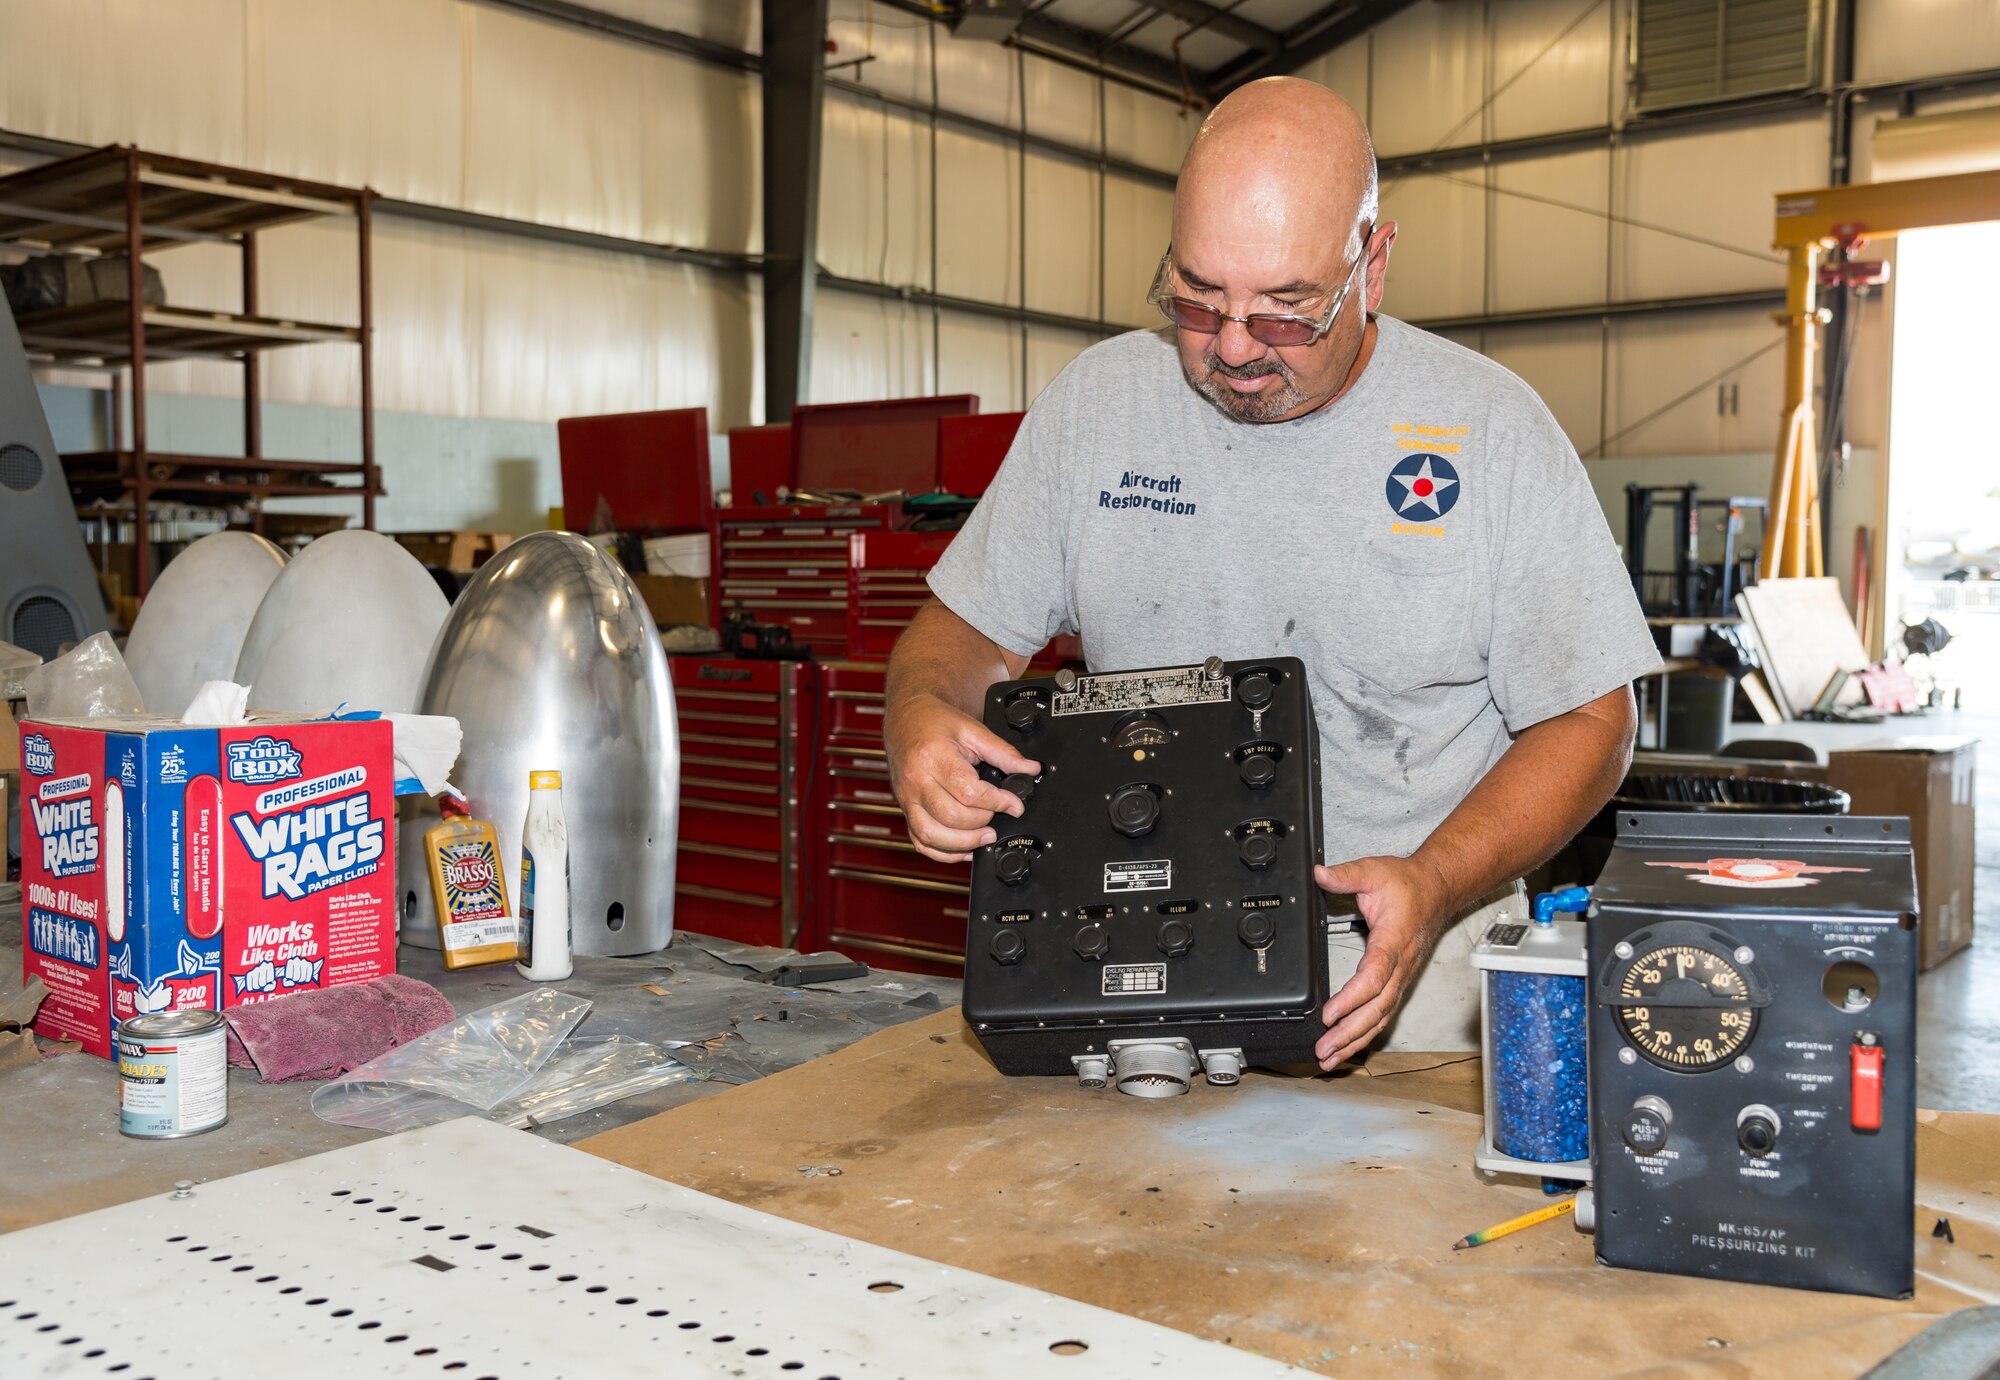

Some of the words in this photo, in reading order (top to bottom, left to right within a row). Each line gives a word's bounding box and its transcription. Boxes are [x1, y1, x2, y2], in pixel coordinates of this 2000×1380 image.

[1392, 423, 1412, 433] AIR
[1416, 424, 1470, 436] MOBILITY
[1397, 438, 1461, 454] COMMAND
[1119, 470, 1182, 492] Aircraft
[1099, 490, 1196, 514] Restoration
[1391, 522, 1445, 537] MUSEUM
[26, 741, 51, 754] TOOL
[232, 744, 294, 759] TOOL
[26, 754, 54, 770] BOX
[161, 758, 185, 774] 25%
[234, 756, 298, 777] BOX
[42, 776, 89, 796] PROFESSIONAL
[264, 770, 363, 809] PROFESSIONAL
[31, 798, 92, 836] WHITE
[200, 809, 210, 832] Easy
[1250, 820, 1270, 828] TUNING
[233, 794, 368, 858] WHITE
[202, 834, 209, 846] to
[1008, 839, 1034, 847] CONTRAST
[44, 826, 99, 876] RAGS
[194, 846, 200, 854] de
[200, 848, 210, 875] Carry
[265, 820, 382, 898] RAGS
[62, 866, 79, 876] PAPER
[80, 864, 96, 874] CLOTH
[308, 875, 342, 892] PAPER
[344, 863, 377, 881] CLOTH
[446, 863, 494, 885] BRASSO
[29, 883, 57, 907] 1000s
[58, 890, 70, 911] Of
[70, 894, 98, 920] Uses!
[202, 878, 210, 912] Handle
[248, 920, 314, 948] Works
[204, 951, 220, 960] 200
[240, 948, 274, 966] Like
[277, 940, 318, 960] Cloth
[1642, 970, 1662, 984] 20
[1712, 973, 1730, 988] 40
[117, 989, 132, 1005] 200
[176, 986, 206, 1002] 200
[117, 1002, 133, 1014] Towels
[176, 1000, 207, 1010] Towels
[1635, 1008, 1649, 1021] 10
[1721, 1012, 1739, 1027] 50
[1640, 1022, 1650, 1030] 75
[1655, 1031, 1672, 1044] 70
[1718, 1032, 1728, 1040] 55
[1676, 1046, 1687, 1054] 65
[1694, 1038, 1712, 1052] 60
[1786, 1042, 1833, 1052] MOMENTARY
[1786, 1072, 1834, 1083] EMERGENCY
[1632, 1124, 1660, 1136] PUSH
[1635, 1156, 1668, 1166] BLEEDER
[1640, 1166, 1664, 1176] VALVE
[1740, 1168, 1780, 1179] INDICATOR
[1692, 1234, 1788, 1256] PRESSURIZING
[1795, 1246, 1816, 1258] KIT
